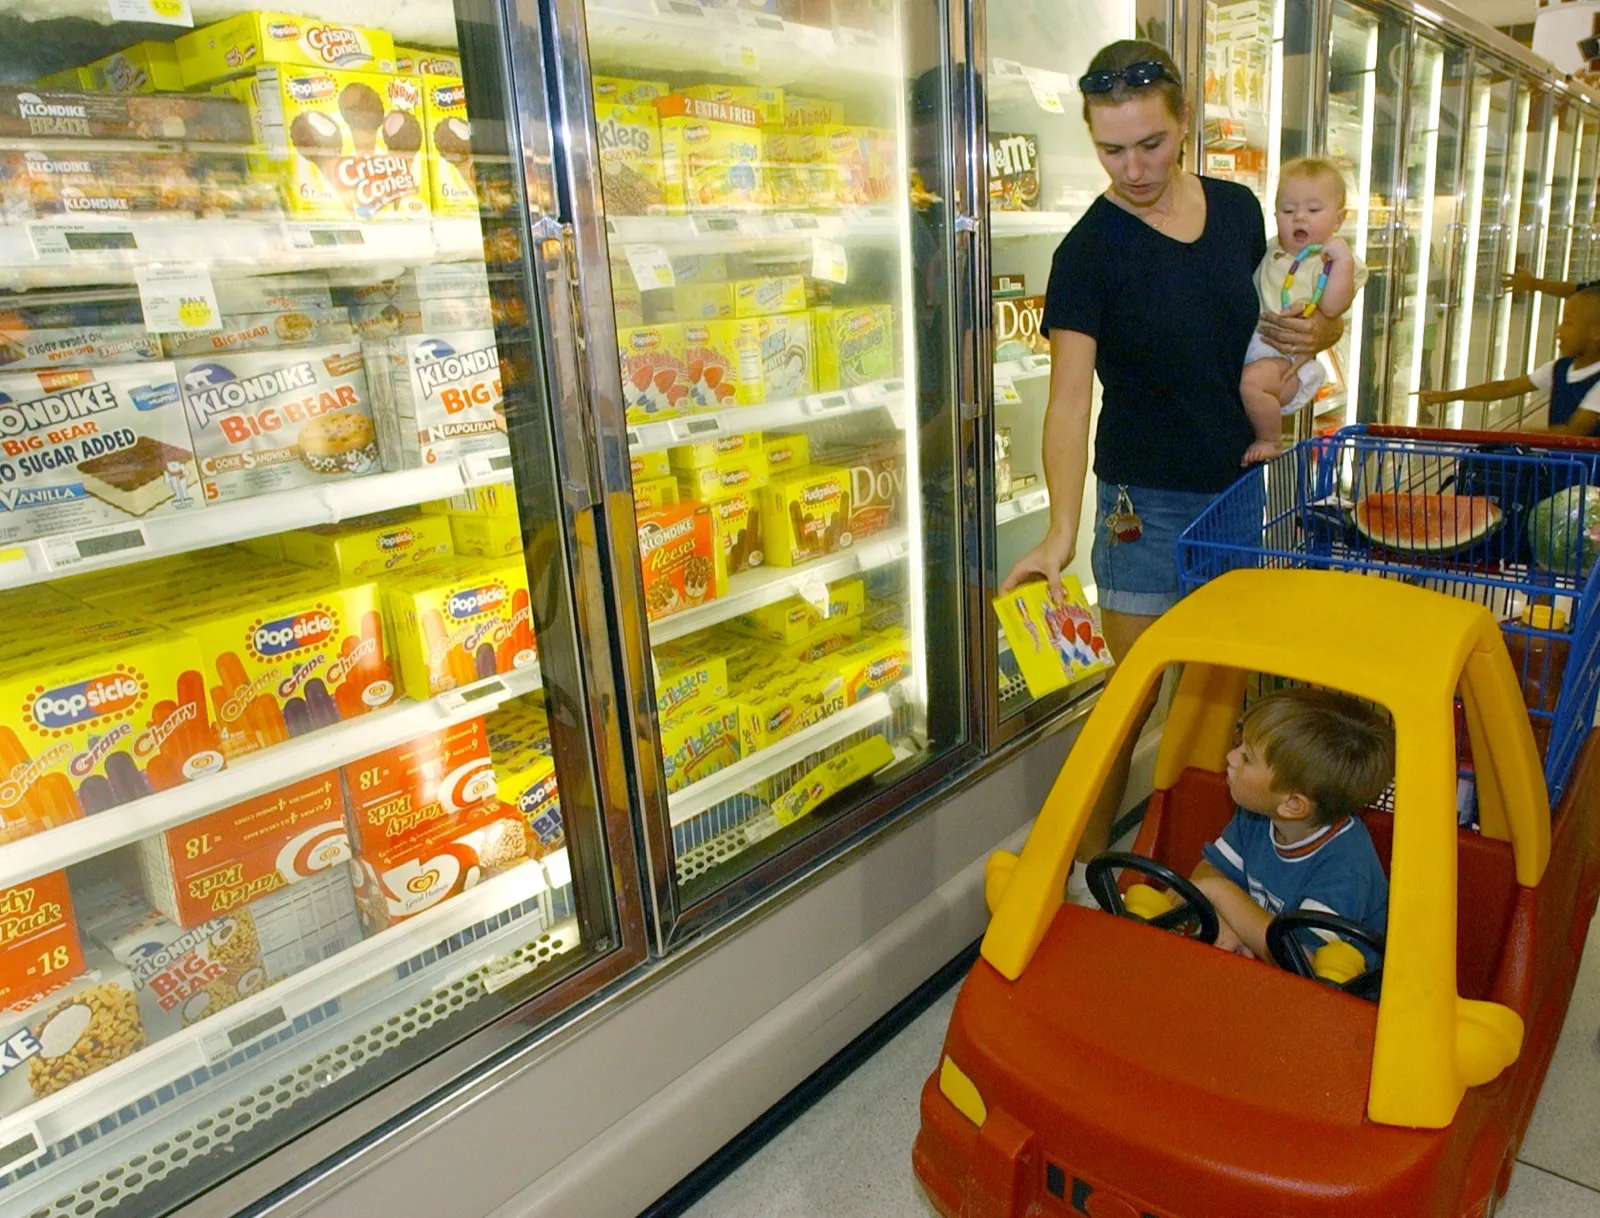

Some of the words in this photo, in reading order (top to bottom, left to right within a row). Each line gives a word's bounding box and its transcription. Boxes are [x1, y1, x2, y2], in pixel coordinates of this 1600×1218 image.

[307, 25, 355, 49] Crispy
[321, 42, 361, 63] Cones
[290, 79, 335, 96] Popsicle
[20, 103, 87, 119] KLONDIKE
[29, 116, 92, 136] HEATH
[684, 98, 692, 114] 2
[694, 100, 726, 120] EXTRA
[729, 105, 756, 126] FREE!
[27, 161, 92, 177] KLONDIKE
[338, 154, 407, 186] Crispy
[301, 183, 309, 197] 6
[356, 174, 414, 204] Cones
[442, 183, 449, 197] 6
[63, 198, 129, 213] KLONDIKE
[997, 300, 1044, 340] Dov
[59, 337, 88, 350] SUGAR
[211, 332, 237, 349] BIG
[51, 372, 80, 387] NEW
[416, 346, 499, 400] KLONDI
[0, 382, 118, 438] ONDIKE
[188, 362, 317, 430] KLONDIKE
[440, 383, 491, 415] BIG
[219, 408, 284, 445] BIG
[282, 385, 359, 425] BEAR
[2, 436, 45, 457] BIG
[47, 421, 100, 445] BEAR
[428, 420, 497, 443] NEAPOLITAN
[0, 463, 17, 485] O
[18, 445, 79, 477] SUGAR
[81, 428, 136, 459] ADDED
[201, 456, 241, 477] COOKIE
[242, 449, 292, 470] SANDWICH
[425, 448, 437, 464] 6
[0, 487, 76, 512] VANILLA
[205, 482, 219, 500] 5
[804, 484, 840, 502] Fudgsicle
[851, 465, 906, 508] Dov
[378, 532, 413, 551] Popsicle
[640, 518, 694, 558] KLONDIKE
[449, 588, 505, 614] Popsicle
[255, 615, 333, 651] Popsicle
[464, 617, 500, 653] Grape
[493, 607, 530, 645] Cherry
[277, 653, 327, 699] Grape
[325, 637, 376, 684] Cherry
[868, 657, 899, 679] Popsicle
[35, 677, 139, 723] Popsicle
[221, 667, 281, 723] Orange
[131, 702, 197, 759] Cherry
[221, 728, 229, 740] 4
[68, 722, 133, 778] Grape
[0, 741, 73, 808] Orange
[324, 780, 333, 794] 4
[359, 767, 381, 790] 18
[323, 797, 332, 811] 6
[368, 794, 412, 825] Pack
[386, 800, 446, 837] Variety
[185, 833, 214, 860] 18
[188, 863, 243, 899] Pack
[211, 869, 291, 912] Variety
[0, 902, 63, 944] Pack
[38, 945, 70, 978] 18
[132, 918, 226, 990] KLONDIKE
[150, 953, 208, 999] BIG
[158, 960, 229, 1013] BEAR
